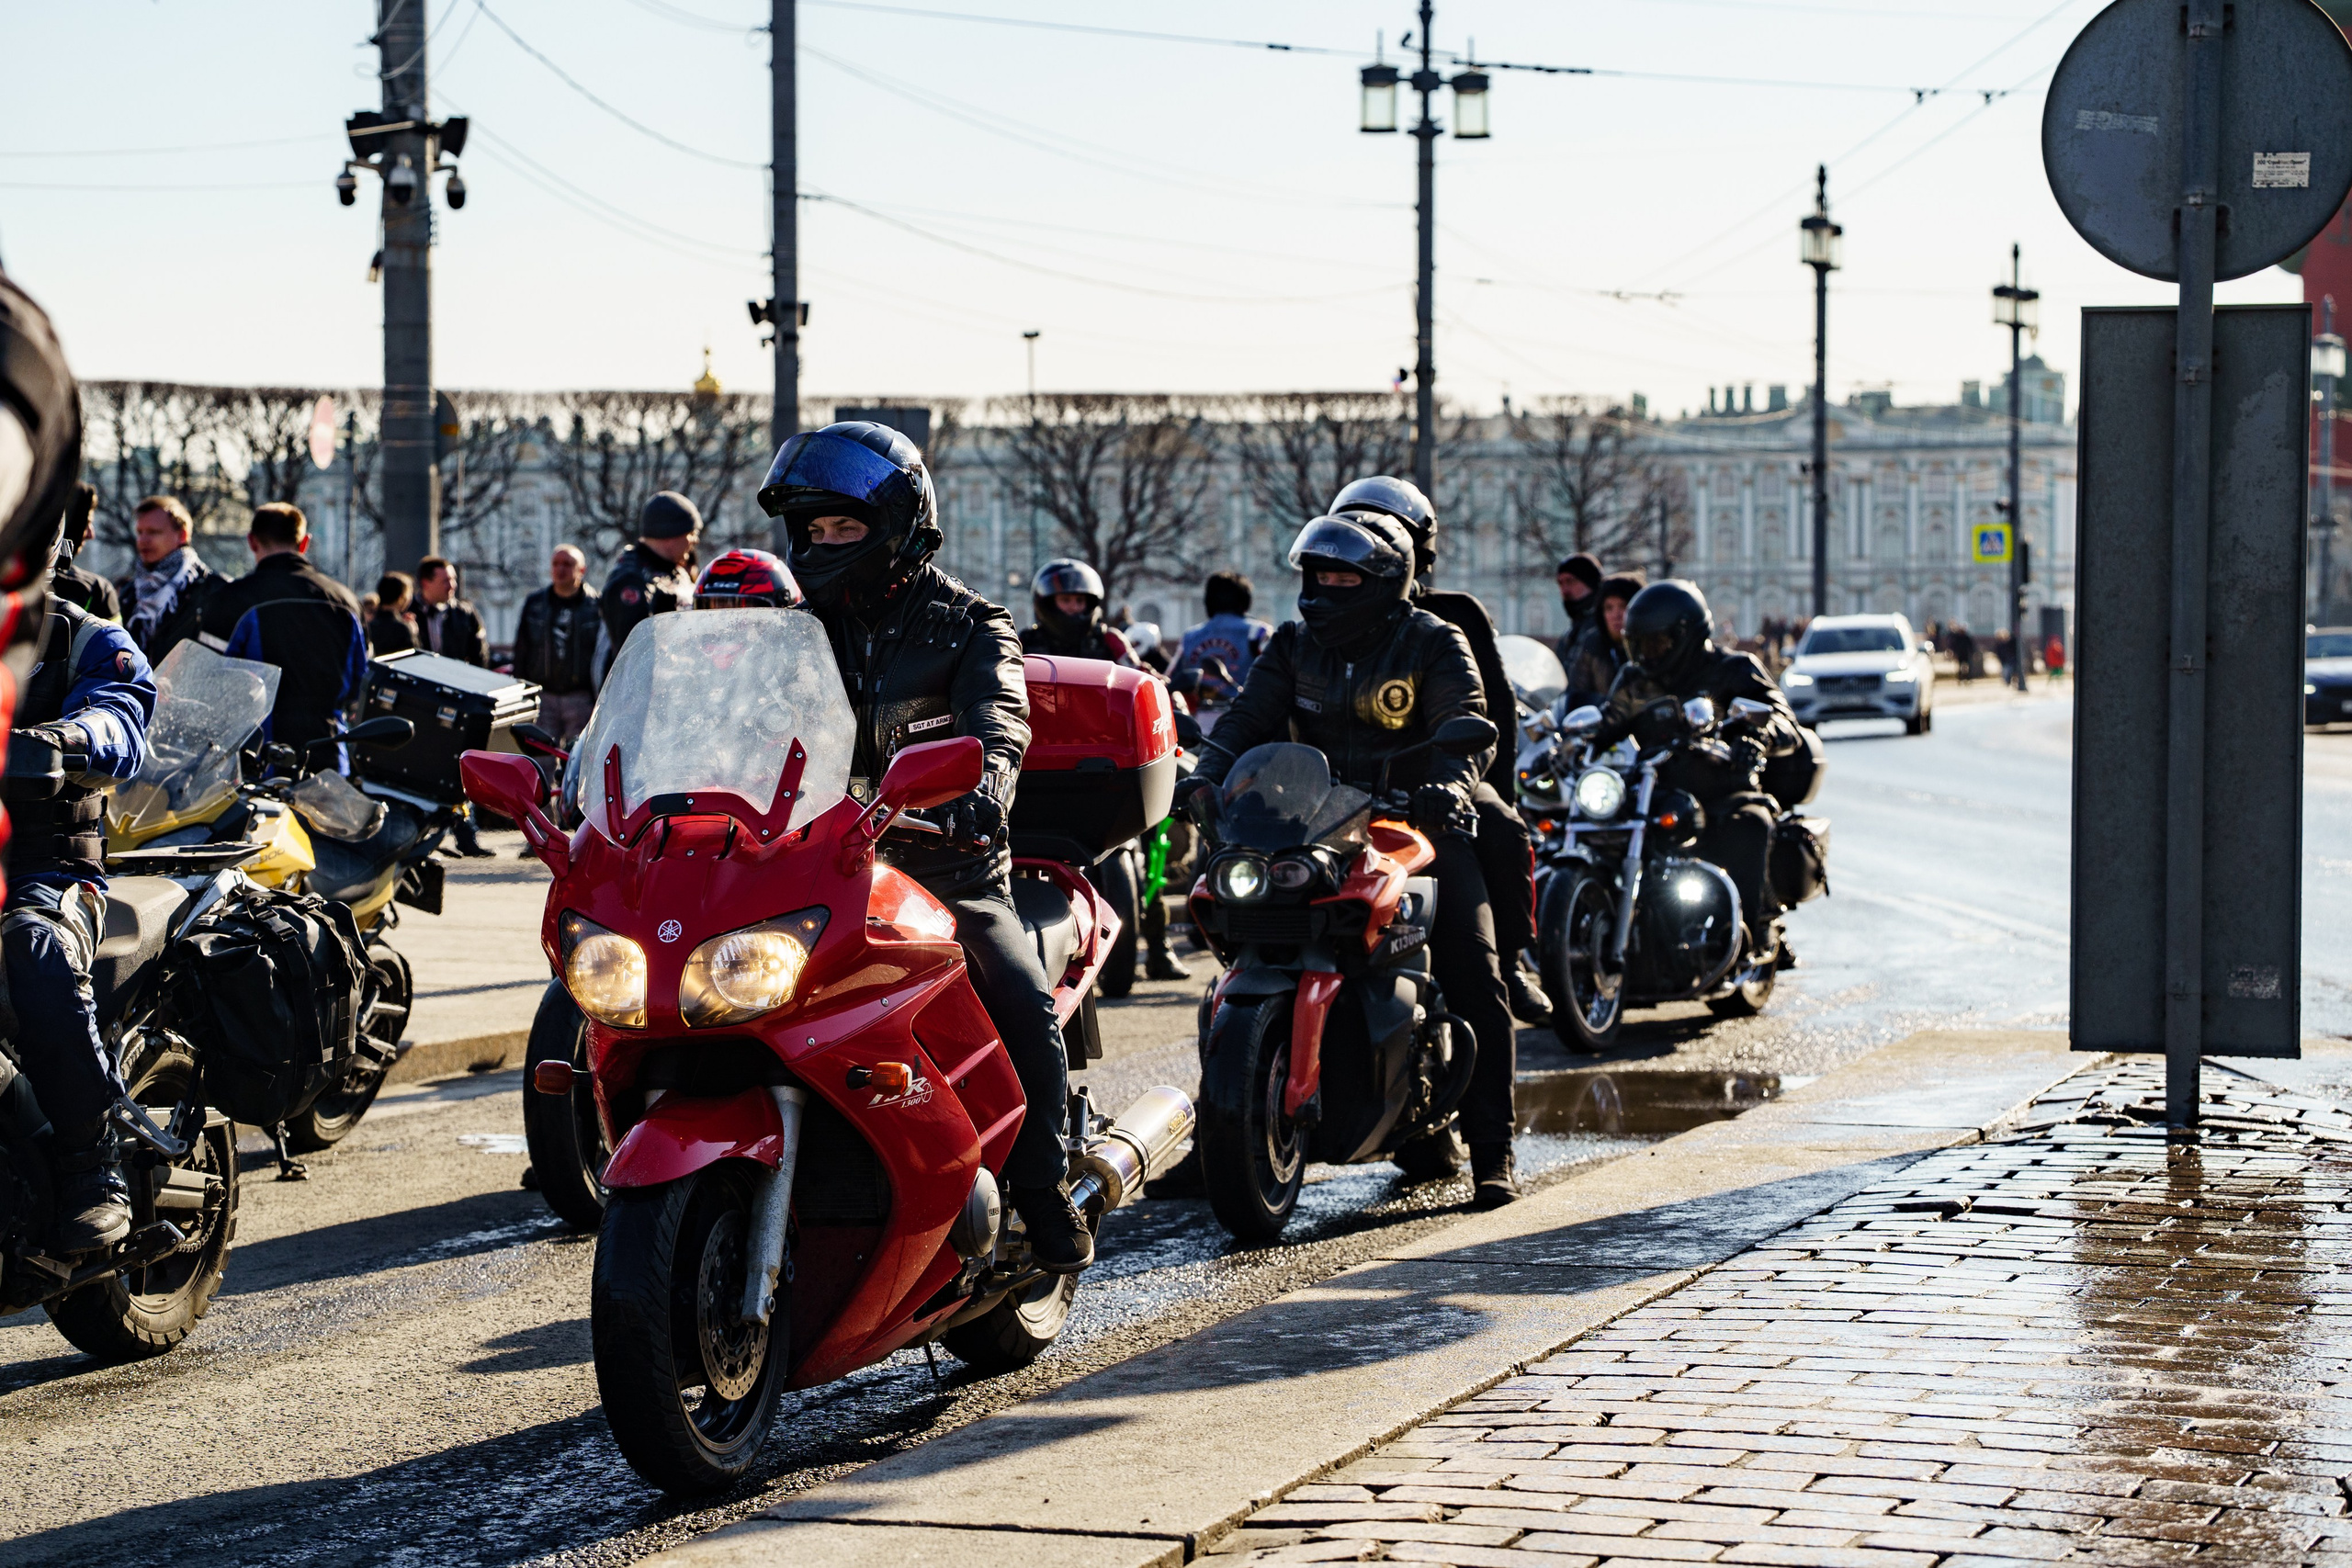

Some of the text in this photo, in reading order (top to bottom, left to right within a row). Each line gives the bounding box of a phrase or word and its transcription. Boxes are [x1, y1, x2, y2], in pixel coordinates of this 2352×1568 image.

[912, 716, 952, 730] SGT AT ARMS
[901, 1097, 922, 1108] 1300
